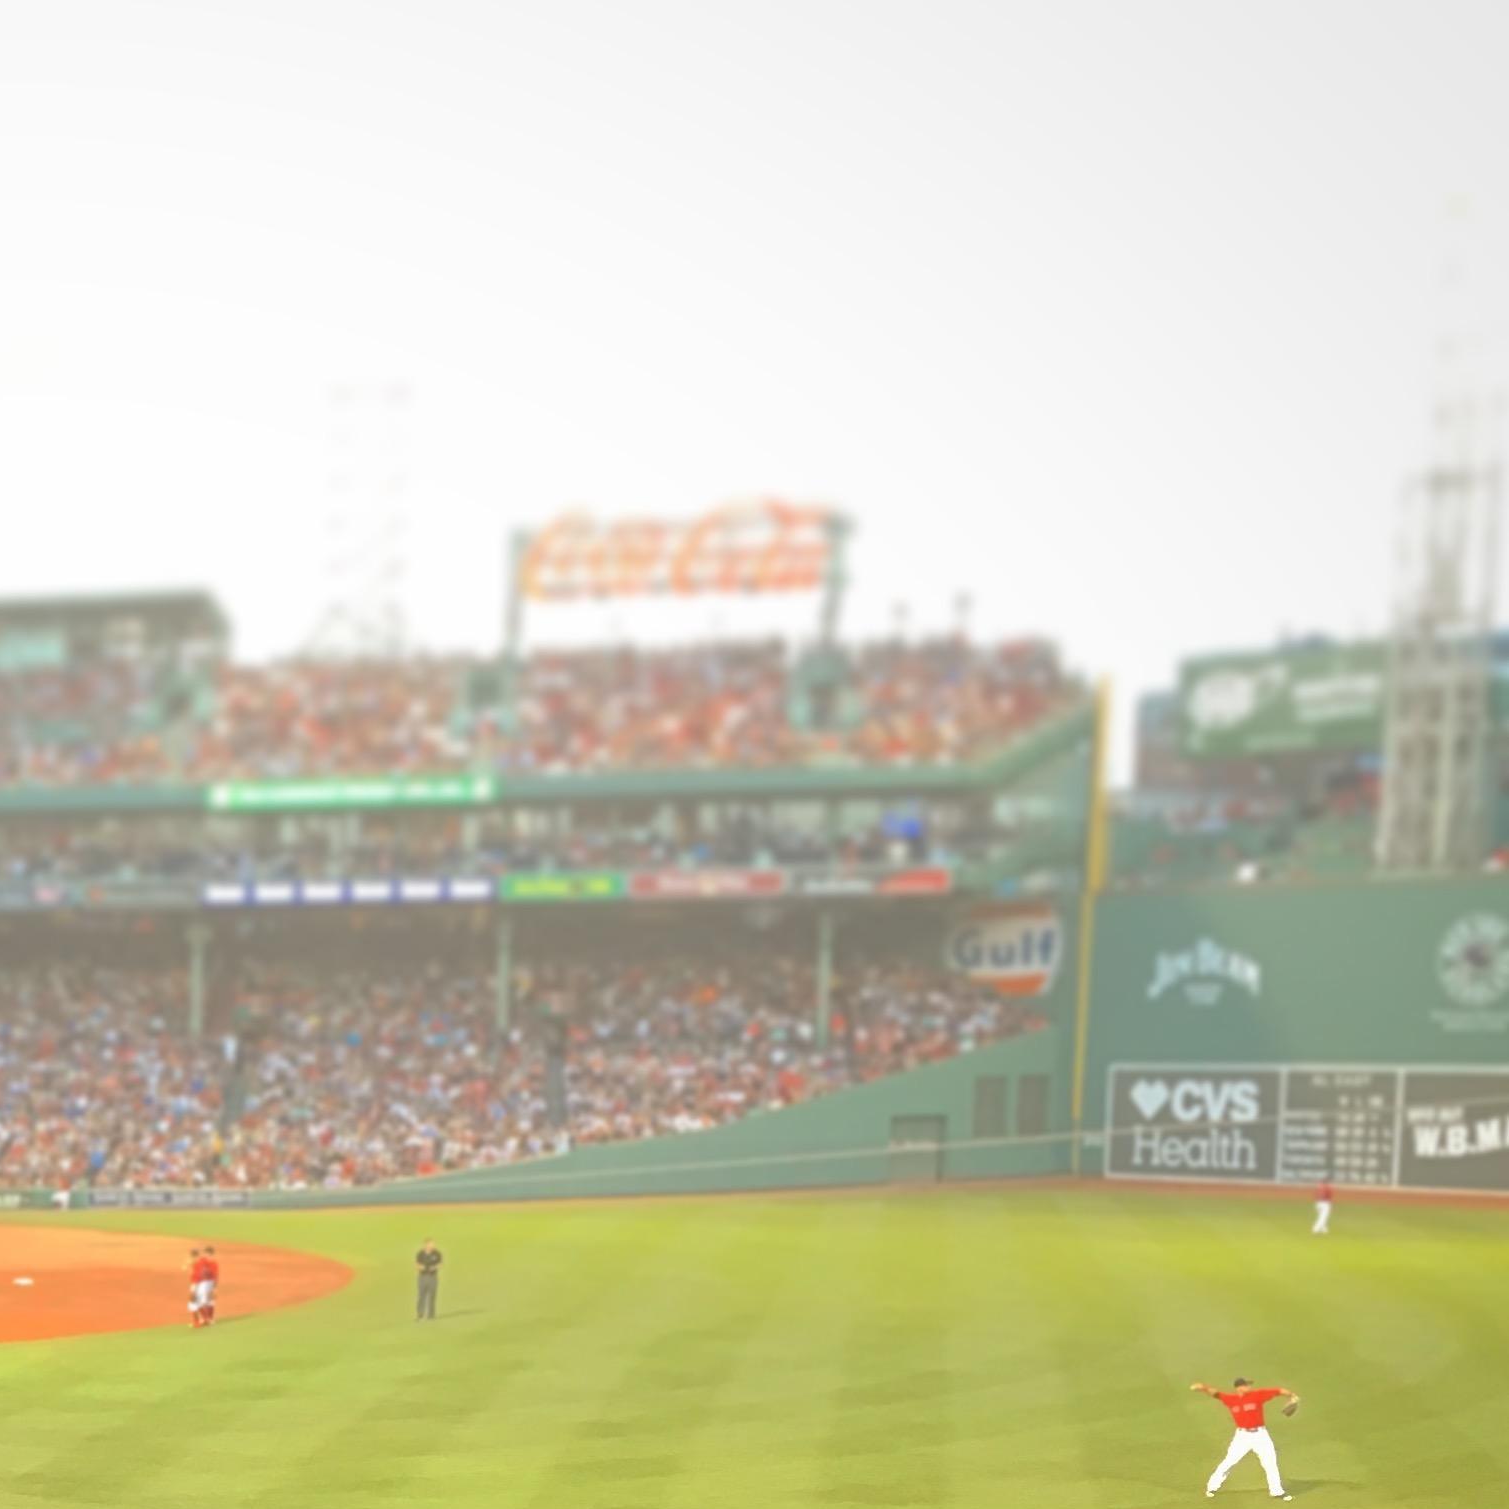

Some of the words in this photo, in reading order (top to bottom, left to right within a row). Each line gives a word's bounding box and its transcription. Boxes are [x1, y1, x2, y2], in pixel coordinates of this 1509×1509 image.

[954, 929, 1055, 969] Gulf
[1171, 1079, 1259, 1122] CVS
[1132, 1125, 1257, 1170] Health
[1413, 1113, 1509, 1157] W.B.M
